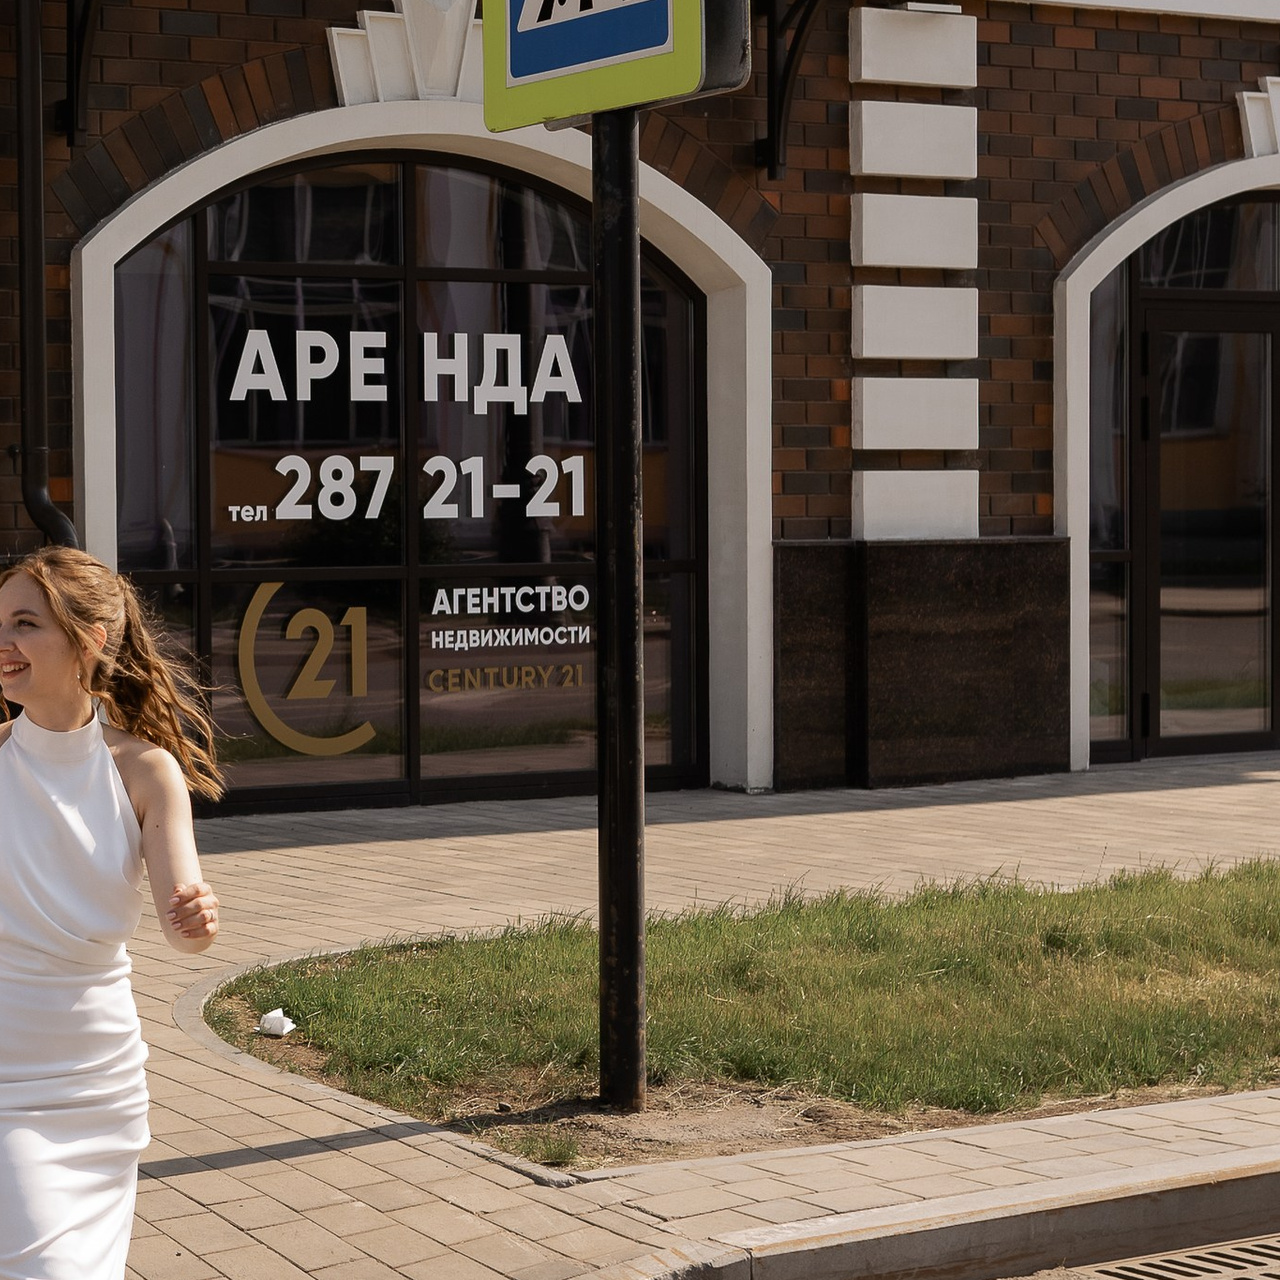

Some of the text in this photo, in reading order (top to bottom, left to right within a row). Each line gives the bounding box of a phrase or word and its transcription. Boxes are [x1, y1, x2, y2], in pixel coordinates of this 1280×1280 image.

[228, 454, 585, 522] тел 287 21-21
[431, 584, 590, 615] АГЕНТСТВО
[431, 625, 590, 651] НЕДВИЖИМОСТИ
[428, 664, 583, 693] CENTURY 21
